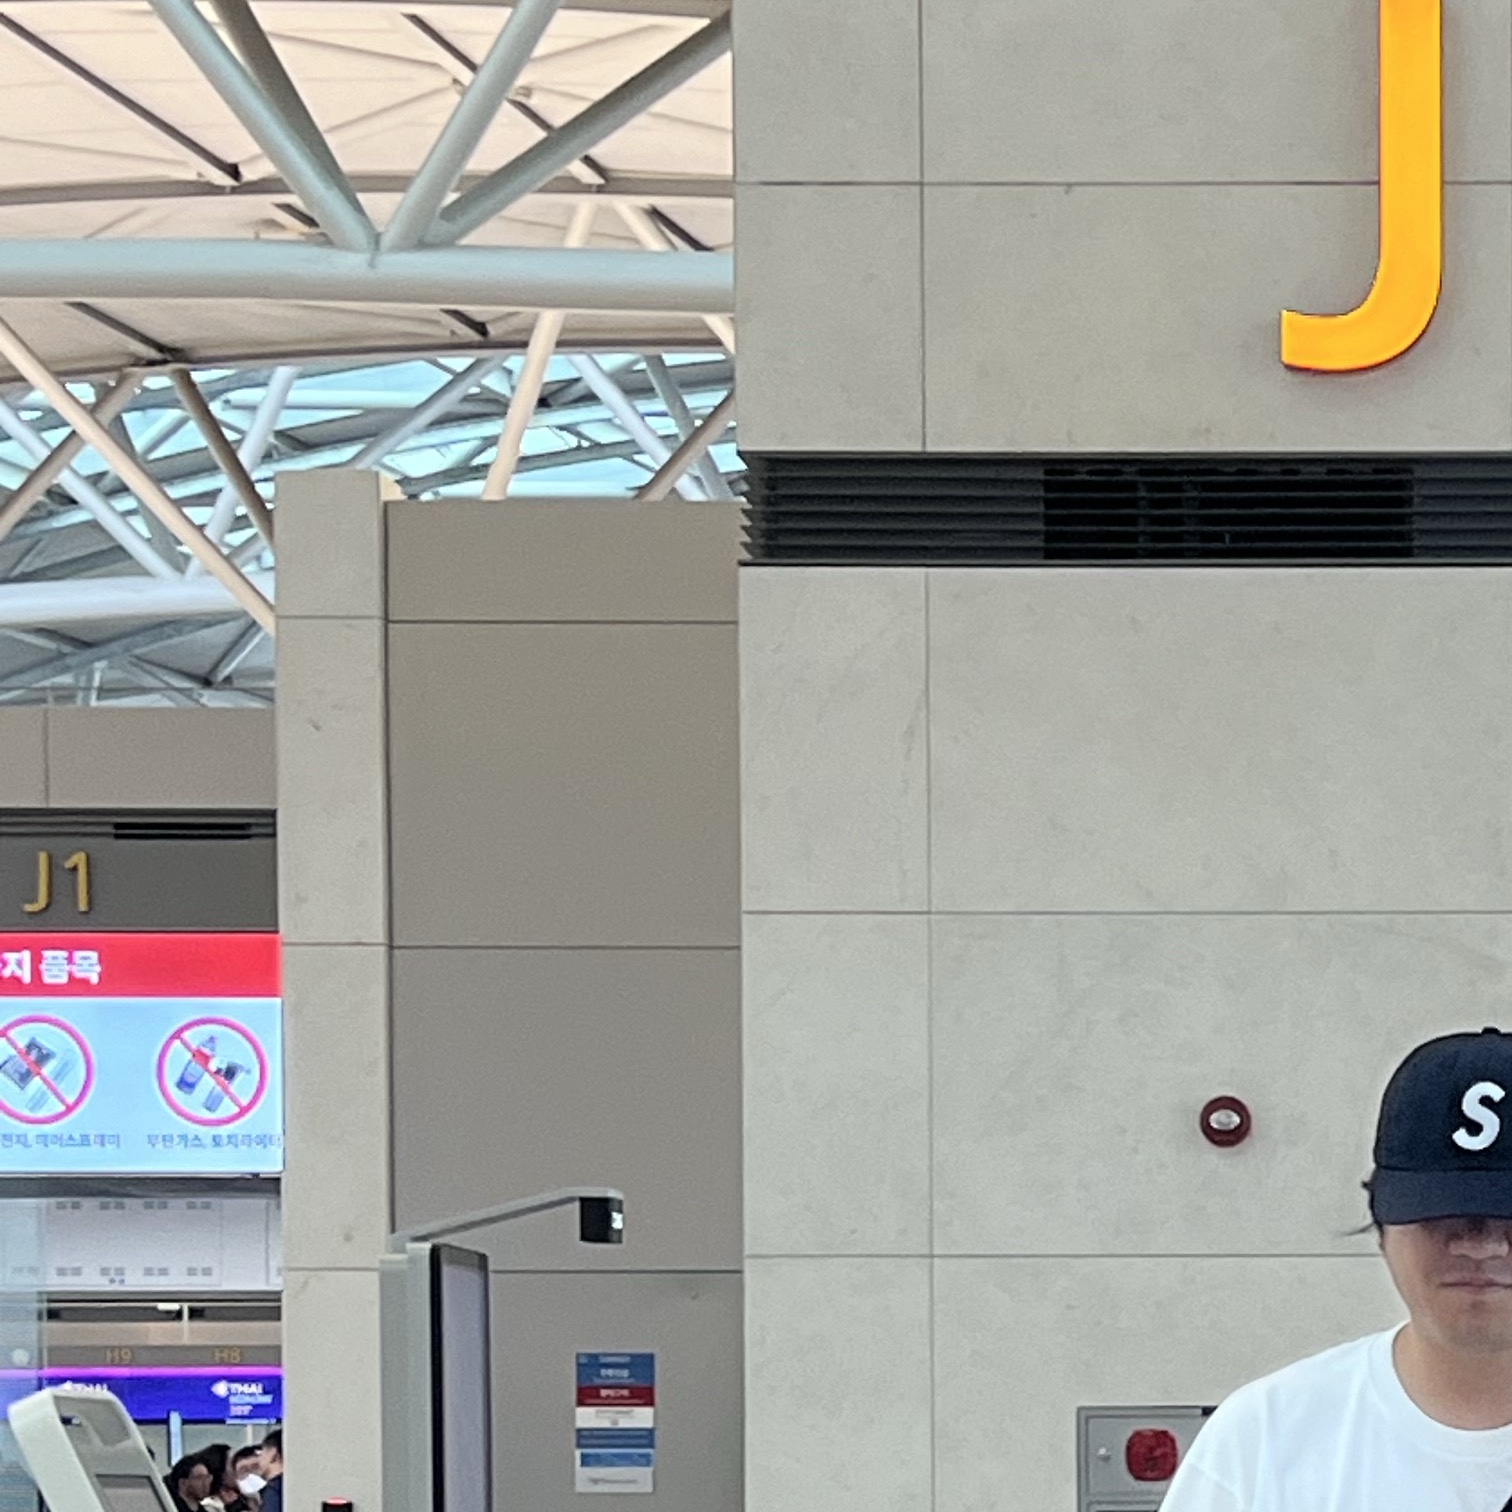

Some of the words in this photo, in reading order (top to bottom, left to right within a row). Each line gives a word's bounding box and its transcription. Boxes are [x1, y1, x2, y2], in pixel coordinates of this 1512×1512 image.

[1280, 0, 1441, 373] J
[23, 850, 89, 912] J1
[0, 949, 31, 985] 지
[39, 949, 102, 985] 품목
[1452, 1081, 1505, 1151] S
